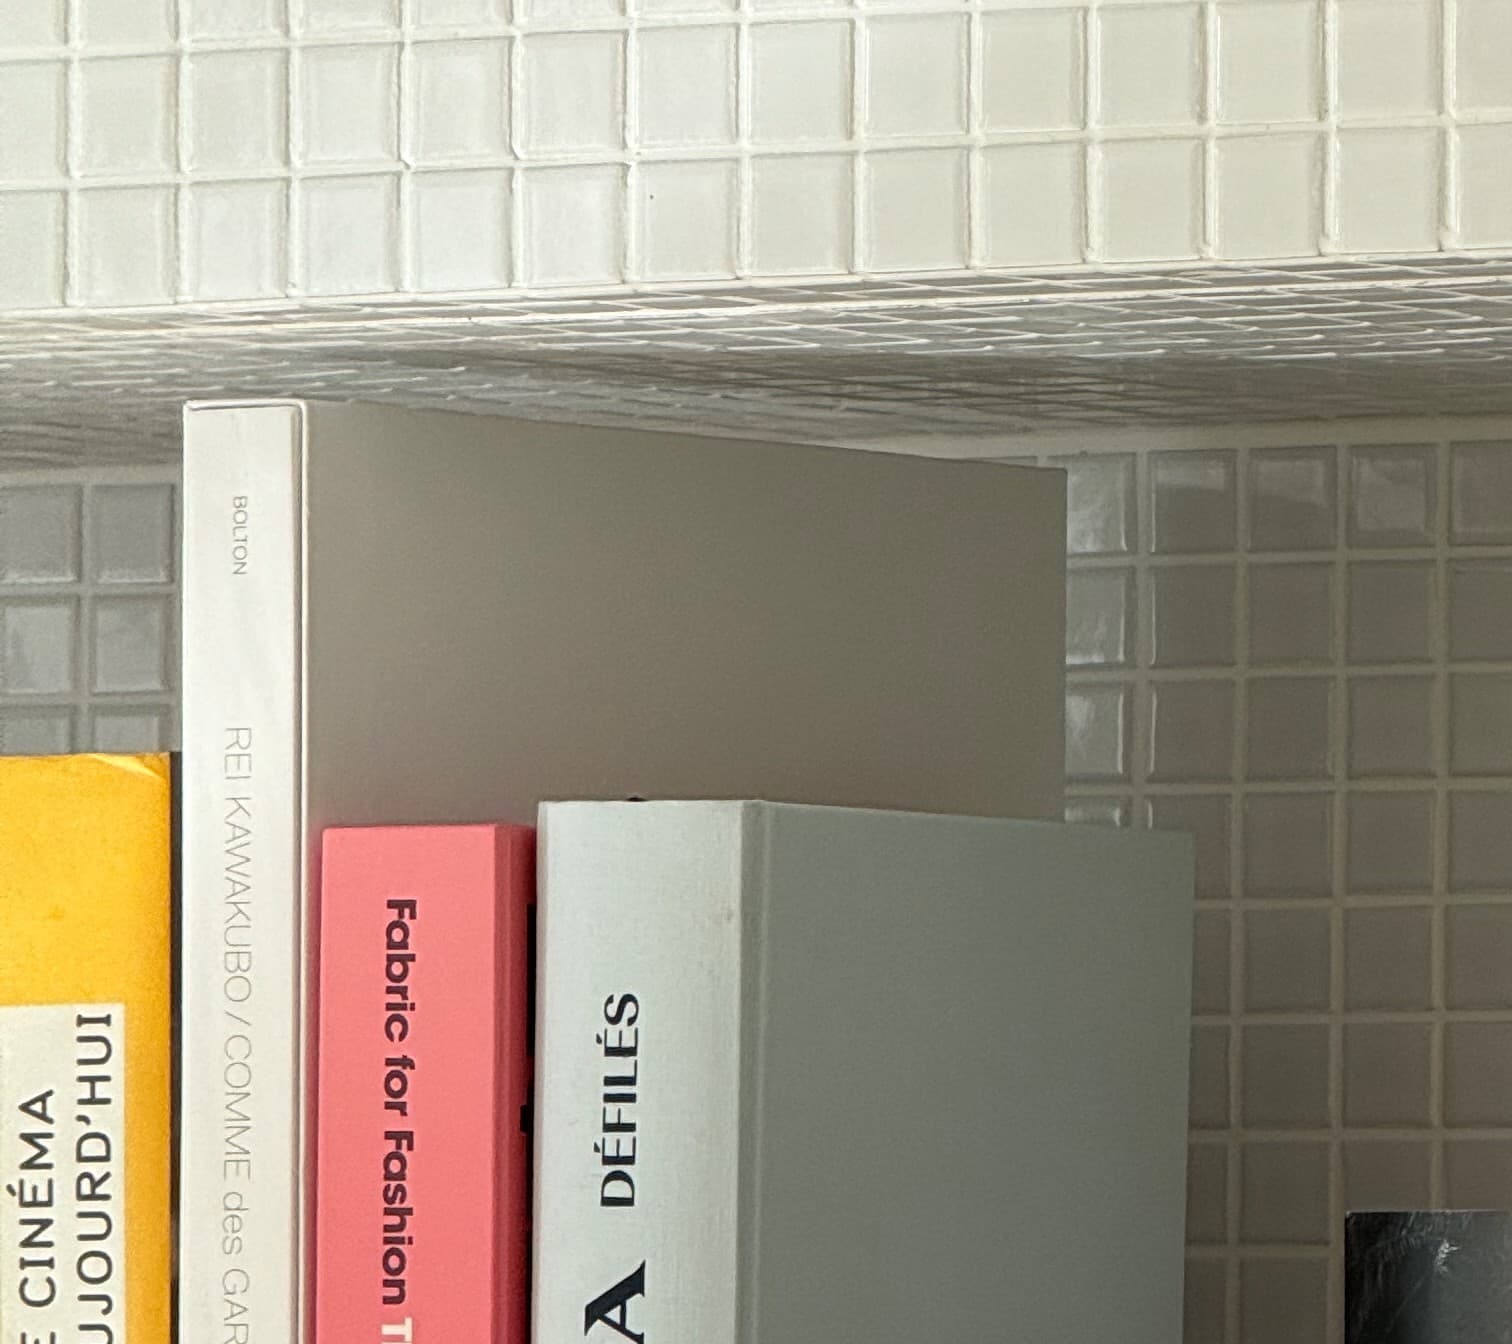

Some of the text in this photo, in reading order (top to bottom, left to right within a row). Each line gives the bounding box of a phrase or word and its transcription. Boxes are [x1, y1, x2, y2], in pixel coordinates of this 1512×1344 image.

[231, 495, 249, 576] BOLTON
[224, 727, 252, 779] REI
[224, 797, 252, 1002] KAWAKUBO
[384, 899, 417, 1044] Fabric
[223, 1034, 252, 1180] COMME
[384, 1055, 416, 1117] for
[593, 993, 641, 1208] DÉFILÉS
[6, 1089, 56, 1308] CINÉMA
[222, 1192, 249, 1256] des
[382, 1131, 414, 1306] Fashion
